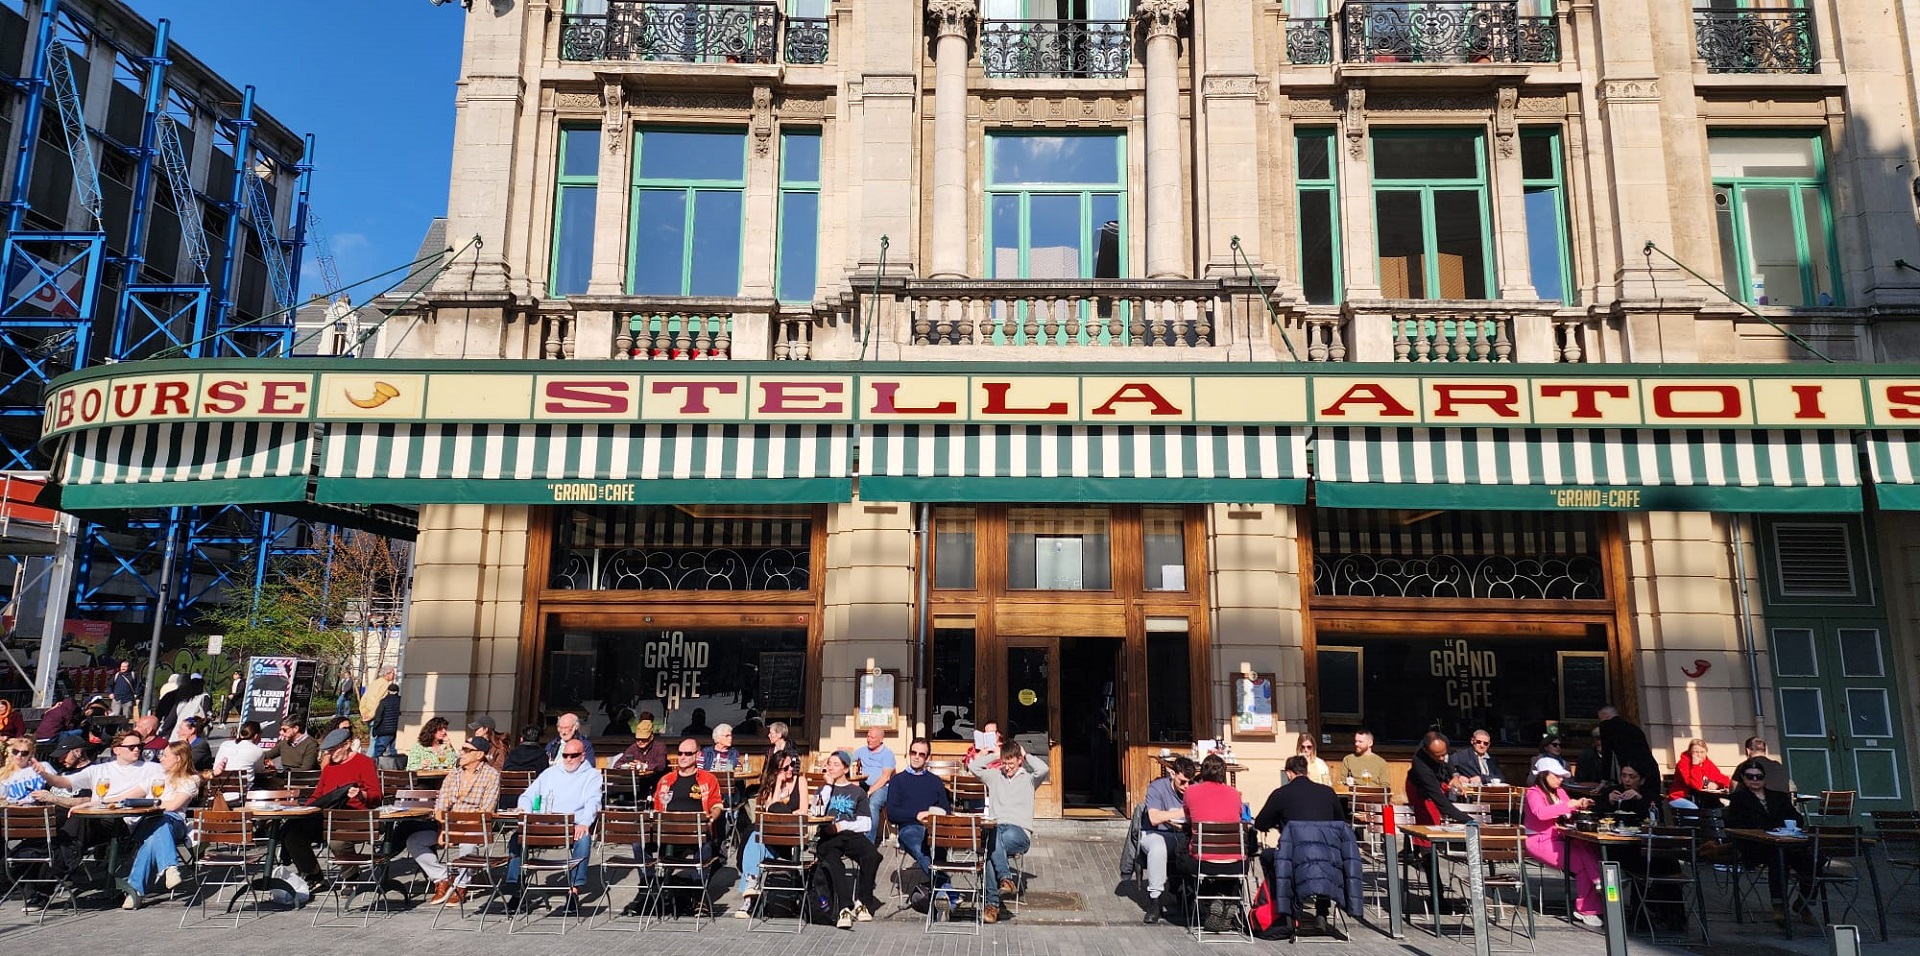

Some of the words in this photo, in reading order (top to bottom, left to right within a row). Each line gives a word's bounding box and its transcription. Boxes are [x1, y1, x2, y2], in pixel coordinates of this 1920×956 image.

[56, 381, 307, 429] BOURSE
[545, 381, 1183, 416] STELLA
[554, 483, 598, 501] GRAND
[605, 483, 635, 501] CAFE
[1557, 489, 1601, 507] GRAND
[1609, 489, 1641, 507] CAFE
[644, 630, 710, 668] GRAND
[661, 630, 670, 639] LE
[1444, 639, 1454, 647] LE
[1429, 639, 1497, 678] GRAND
[253, 697, 281, 708] WIJF!
[655, 670, 701, 710] CAFE
[1445, 679, 1494, 714] CAFE
